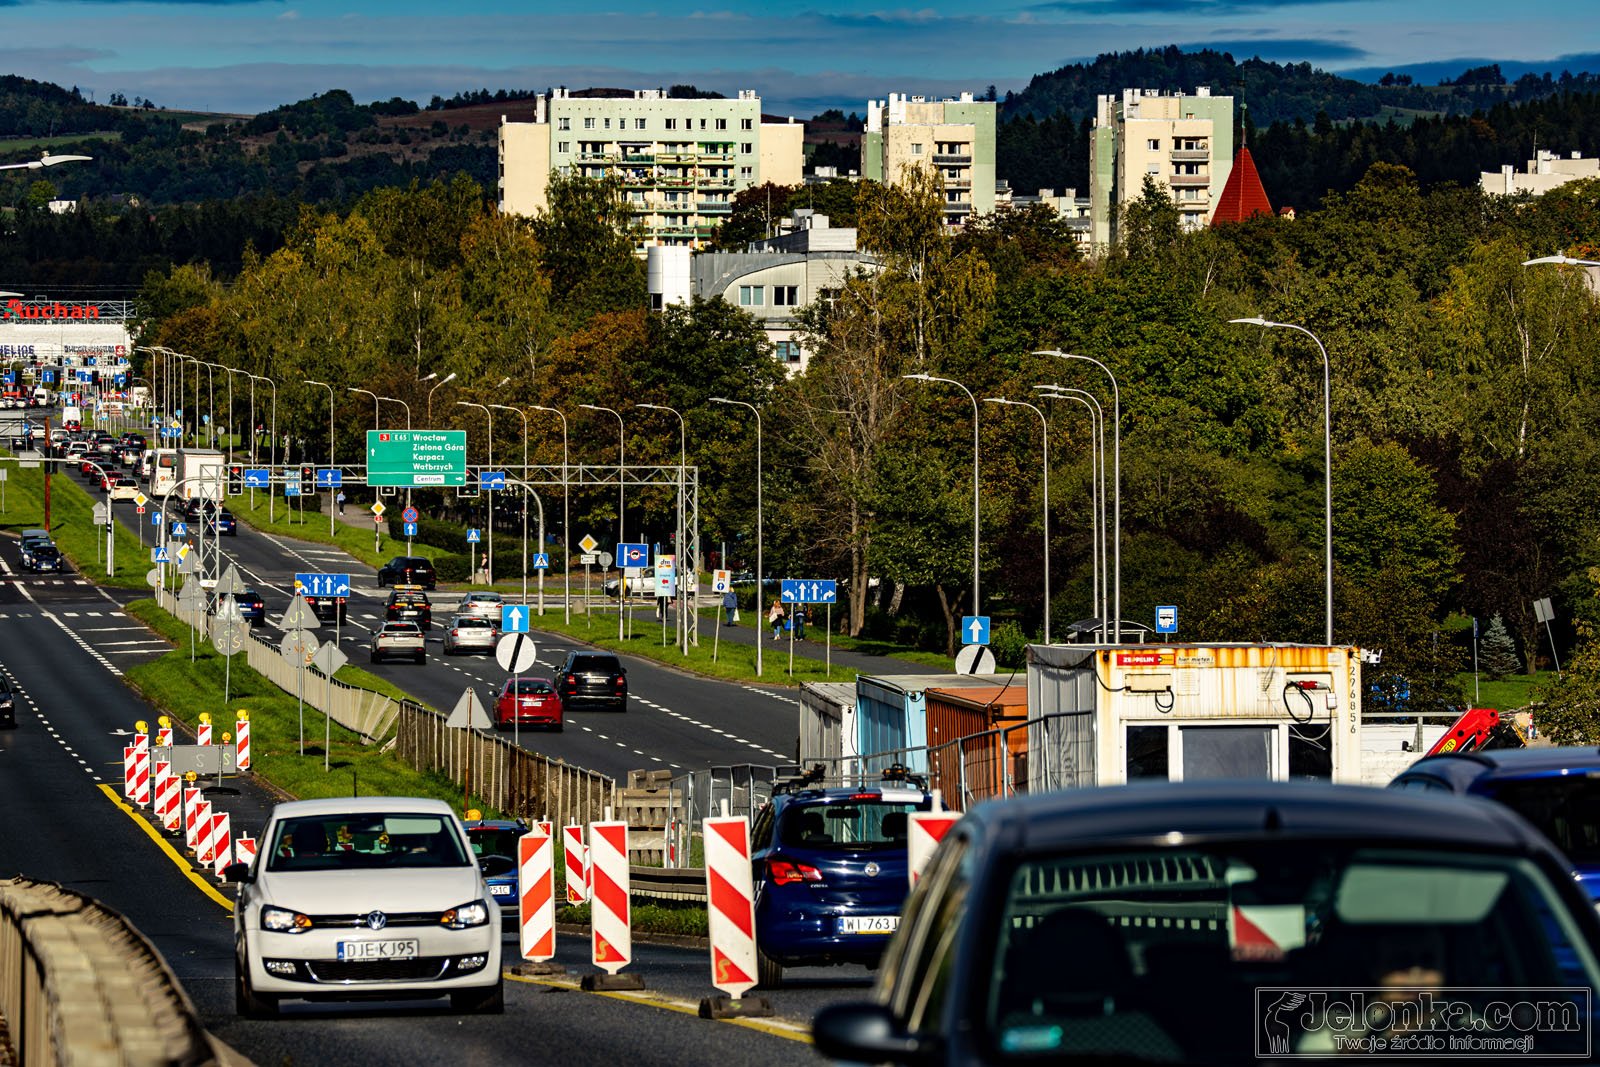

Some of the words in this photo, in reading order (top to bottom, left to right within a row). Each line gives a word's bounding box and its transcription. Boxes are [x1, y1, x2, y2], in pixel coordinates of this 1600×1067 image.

[3, 298, 99, 319] Auchan
[413, 433, 447, 441] Wrocław
[413, 443, 443, 451] Zielona
[444, 443, 464, 451] Góra
[413, 453, 445, 462] Karpacz
[413, 463, 453, 471] Wałbrzych
[347, 943, 375, 957] DJE
[379, 941, 414, 956] KJ95
